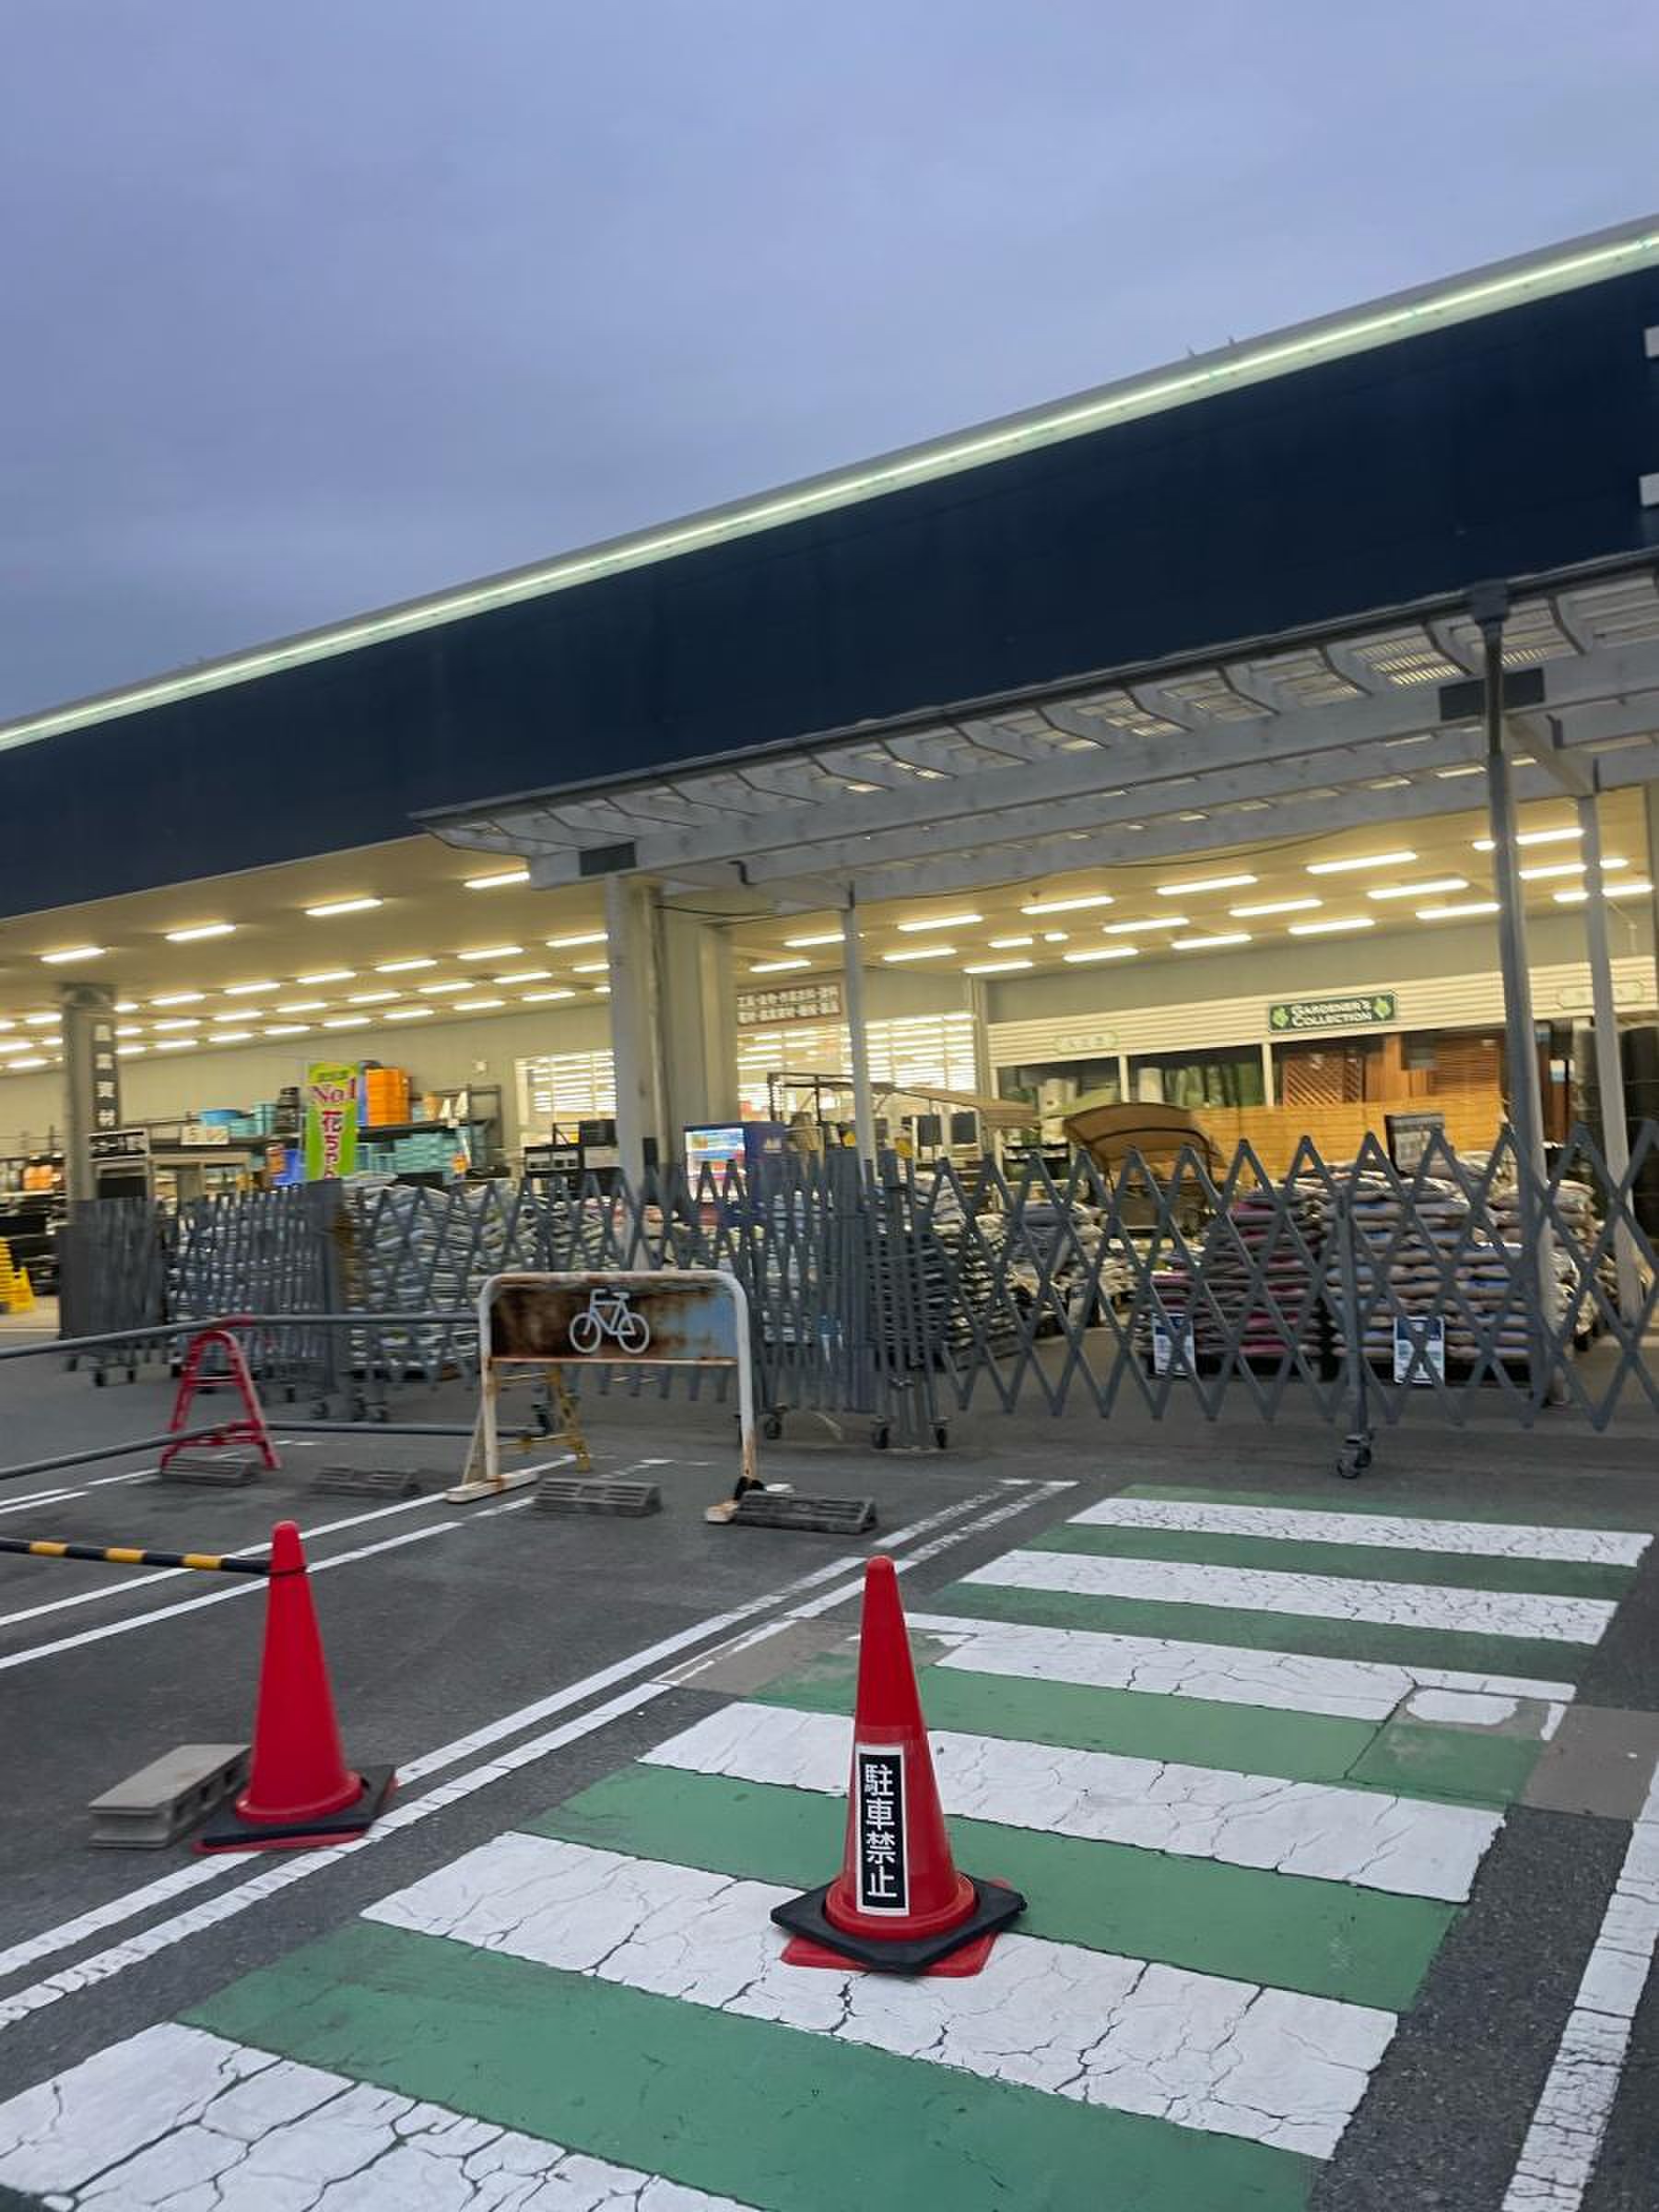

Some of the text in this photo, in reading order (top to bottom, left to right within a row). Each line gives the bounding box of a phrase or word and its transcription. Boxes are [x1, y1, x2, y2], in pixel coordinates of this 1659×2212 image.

[1291, 1011, 1371, 1027] COLLECTION
[865, 1763, 898, 1898] 駐車禁止
